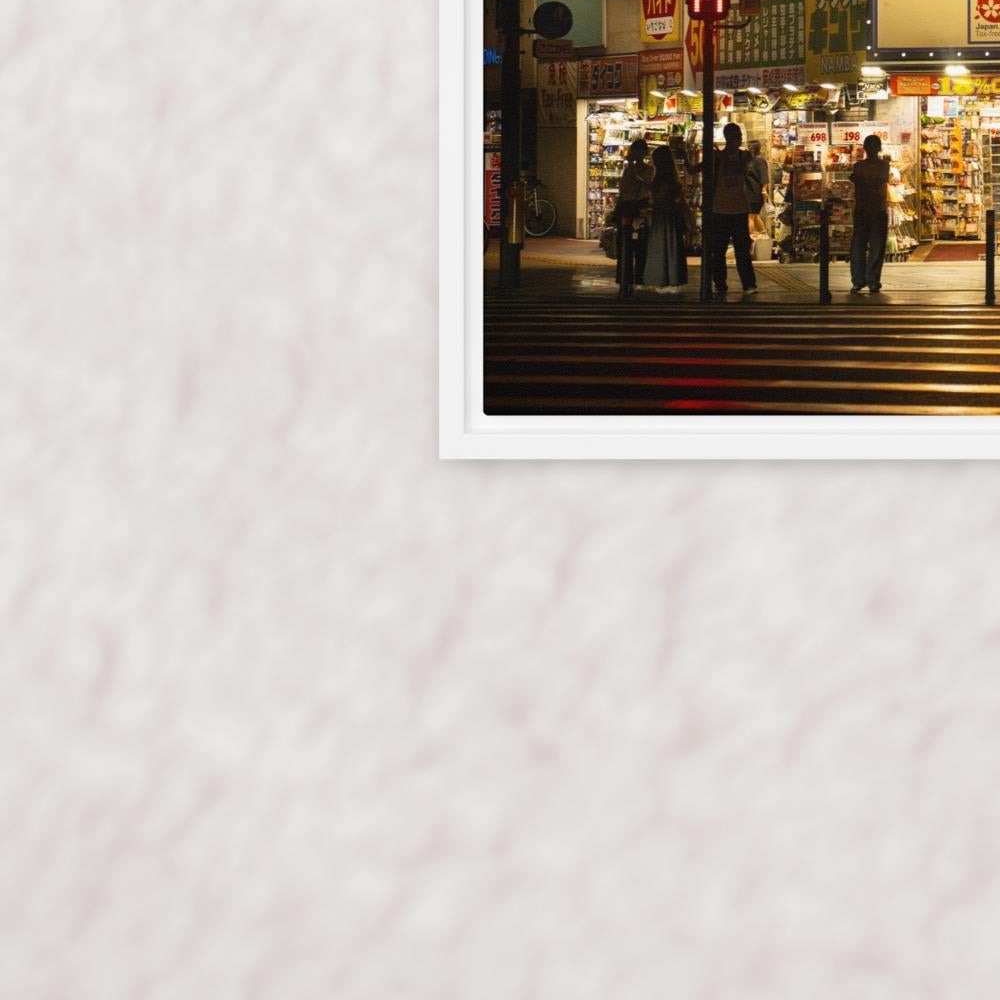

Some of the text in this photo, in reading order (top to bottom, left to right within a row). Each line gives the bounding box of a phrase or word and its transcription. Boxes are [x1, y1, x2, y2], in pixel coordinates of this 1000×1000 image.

[975, 23, 999, 31] Japan.
[821, 55, 858, 74] NAMBA
[810, 133, 827, 142] 698
[844, 131, 861, 141] 198
